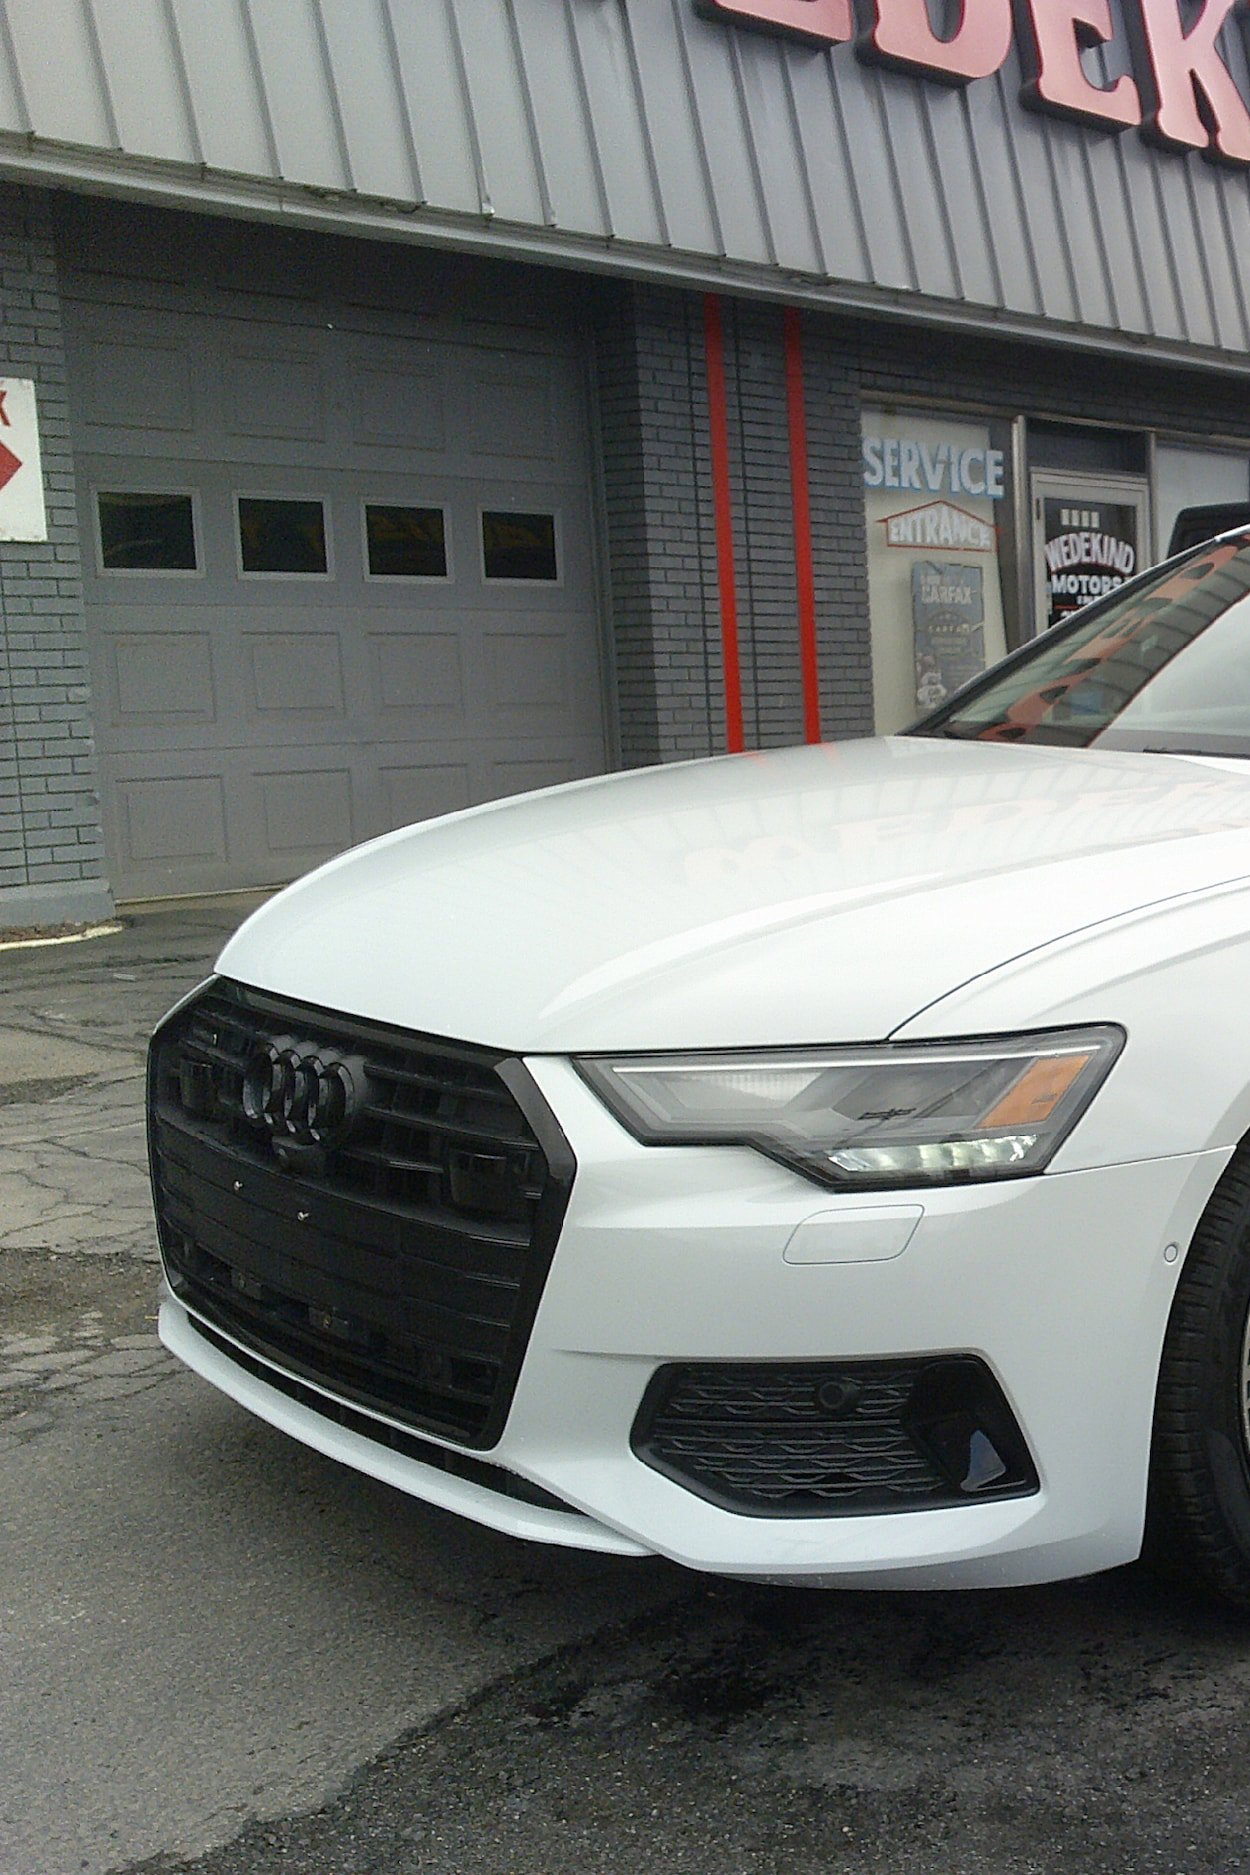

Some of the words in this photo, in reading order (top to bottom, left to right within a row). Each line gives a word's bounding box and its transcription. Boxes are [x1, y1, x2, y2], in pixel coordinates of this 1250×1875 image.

[862, 436, 1005, 498] SERVICE
[888, 505, 992, 548] ENTRANCE
[1045, 531, 1135, 575] WEDEKIND
